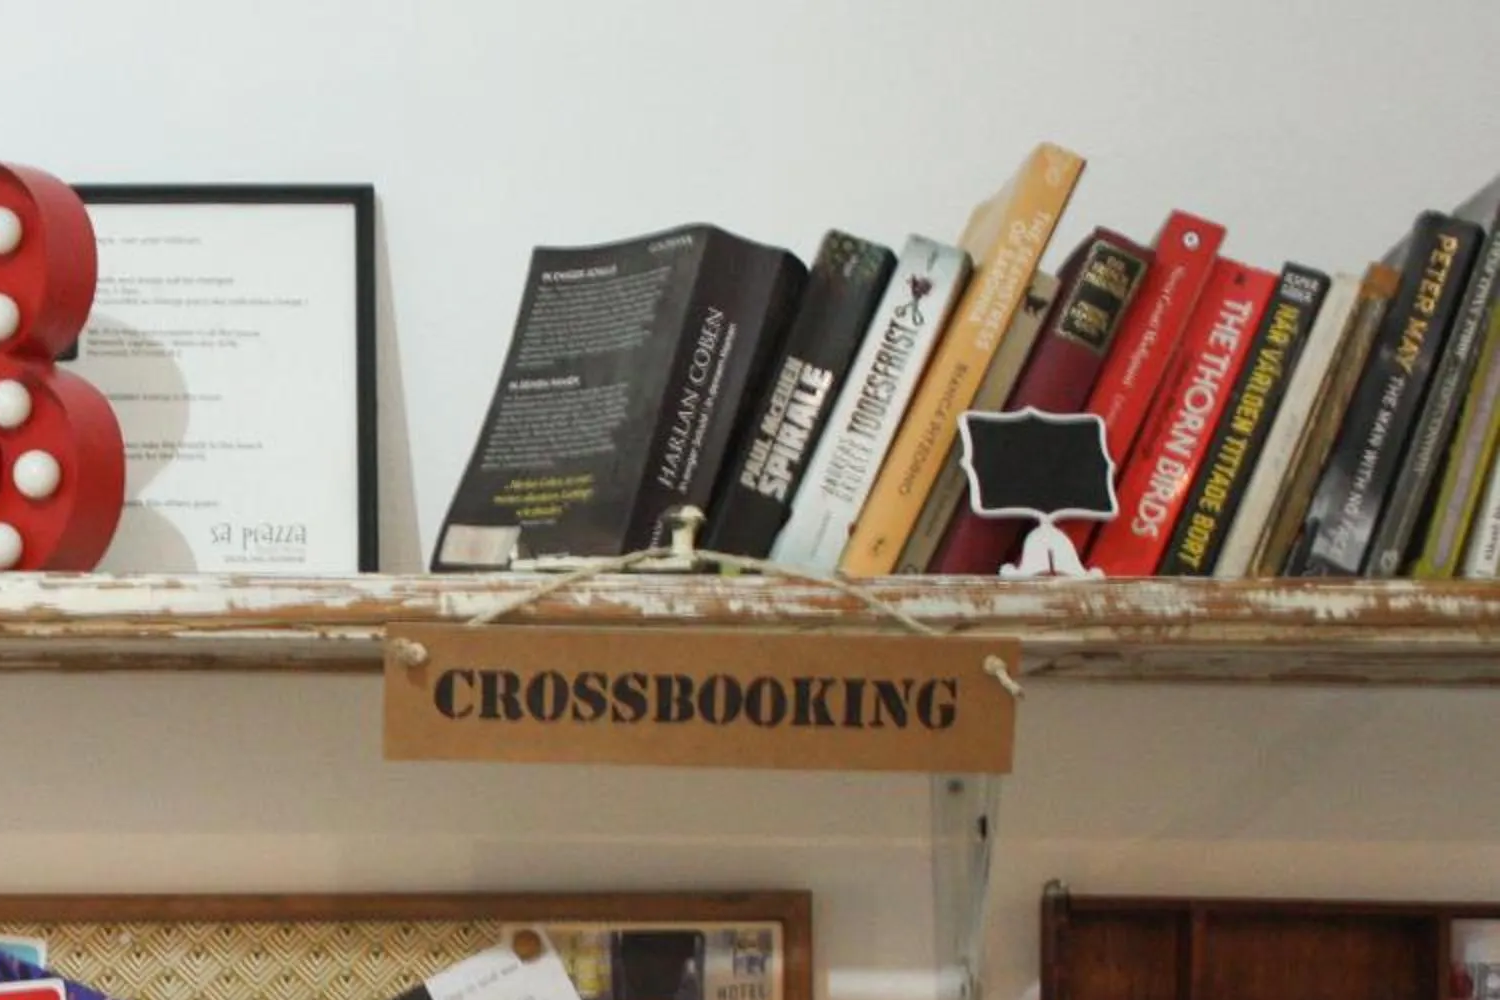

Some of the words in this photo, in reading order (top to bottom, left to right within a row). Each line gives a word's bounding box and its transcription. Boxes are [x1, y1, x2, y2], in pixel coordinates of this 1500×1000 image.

[1413, 233, 1459, 313] PETER
[1206, 297, 1256, 355] THE
[1394, 316, 1426, 375] MAY
[659, 389, 698, 487] HARLAN
[689, 306, 724, 383] COBEN
[848, 320, 917, 439] TODESFRIST
[1163, 352, 1231, 458] THORN
[1381, 376, 1404, 407] THE
[758, 363, 832, 501] SPIRALE
[1368, 409, 1392, 447] MAN
[739, 438, 773, 488] PAUL
[1352, 449, 1378, 490] WITH
[1129, 454, 1188, 540] BIRDS
[1343, 491, 1362, 516] NO
[434, 669, 958, 729] CROSSBOOKING
